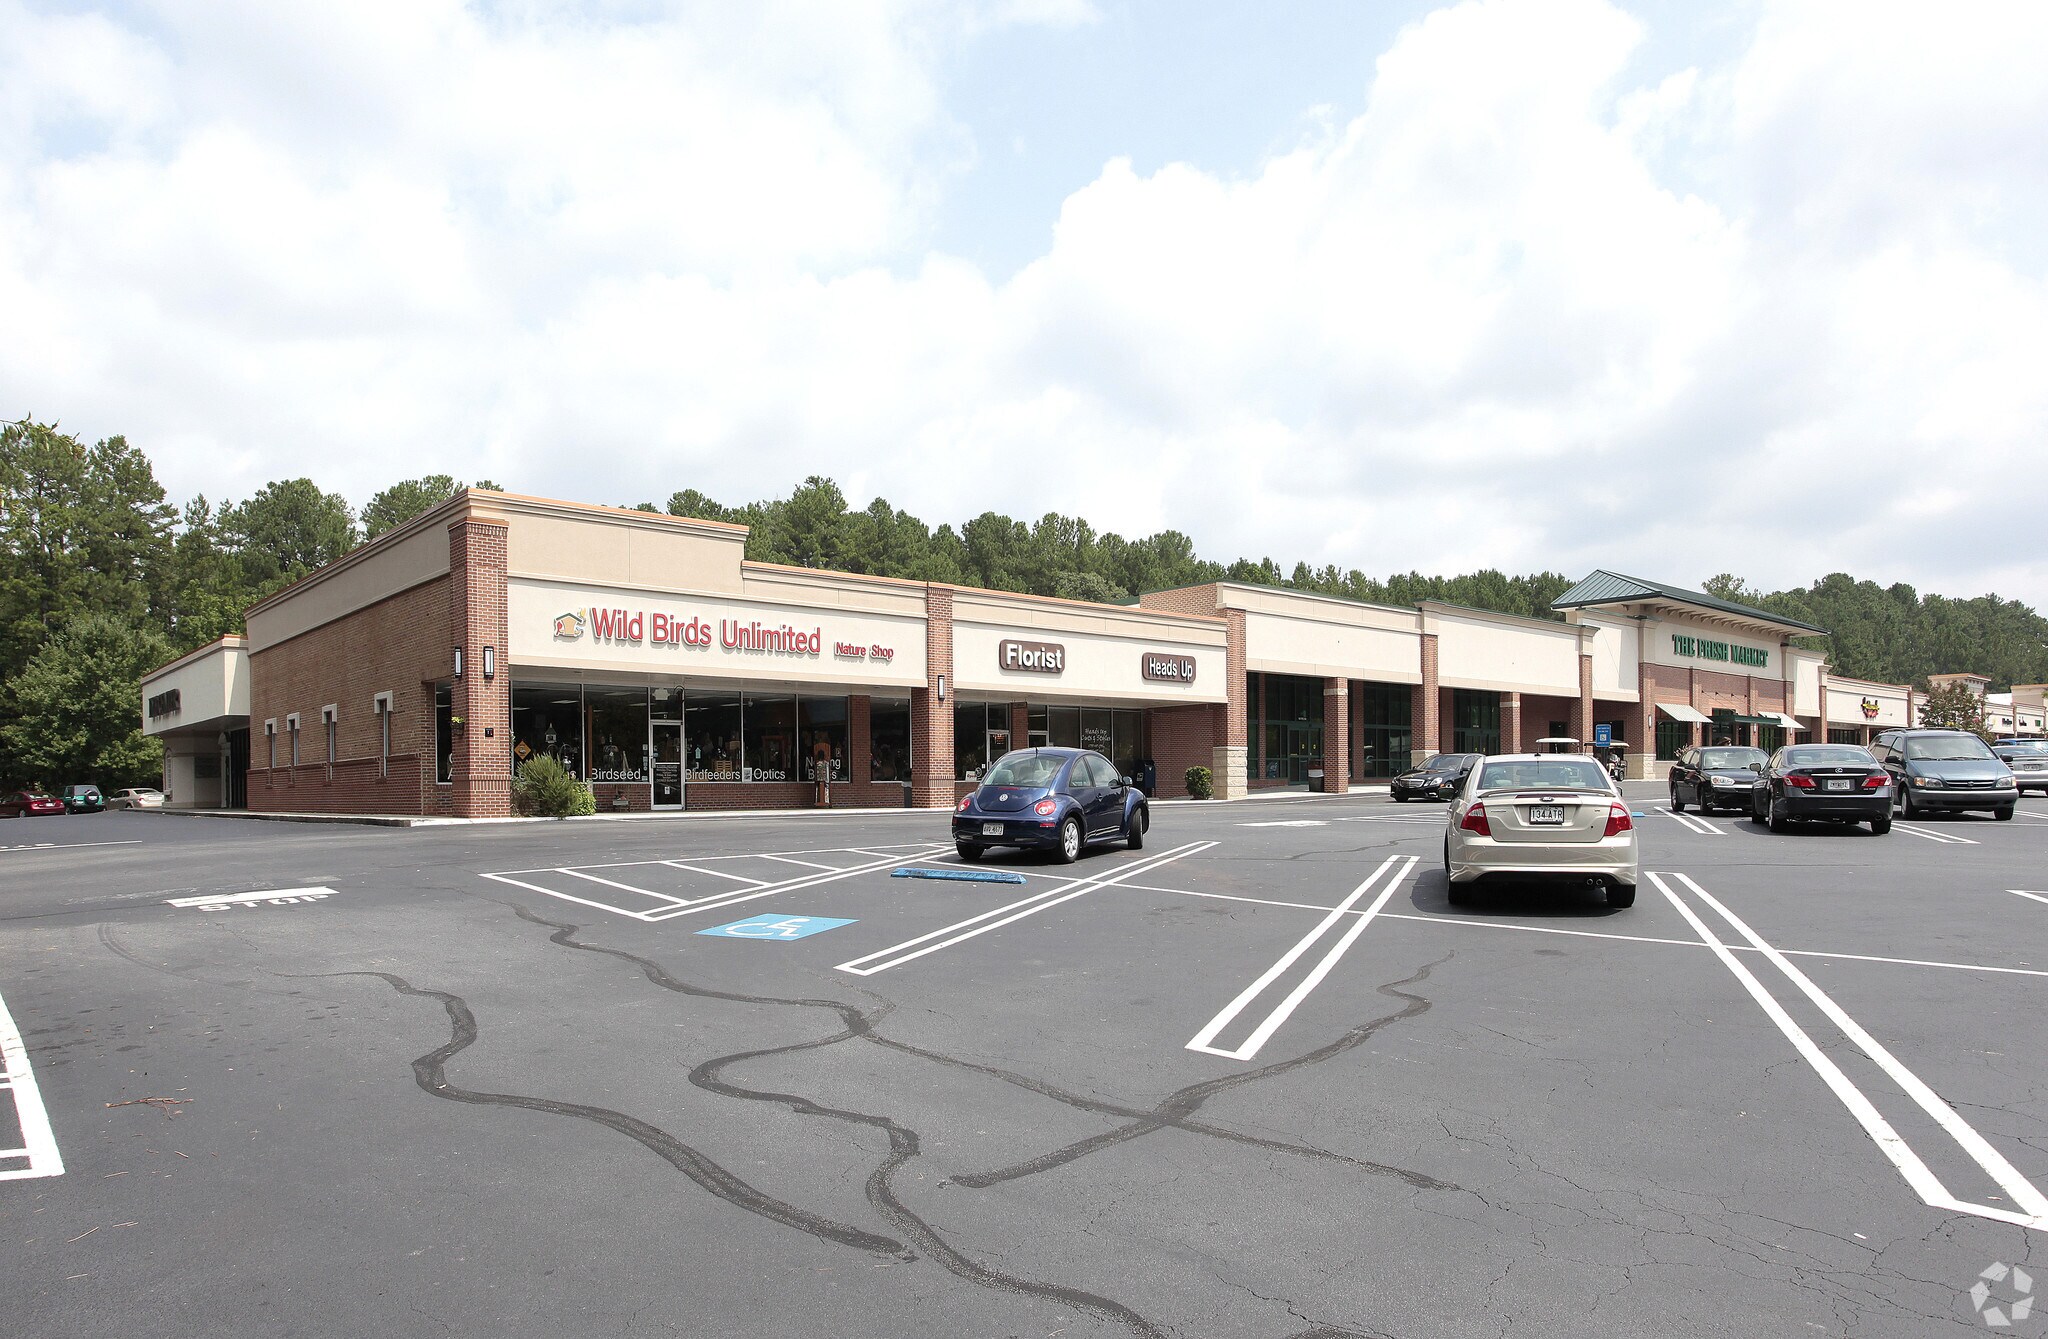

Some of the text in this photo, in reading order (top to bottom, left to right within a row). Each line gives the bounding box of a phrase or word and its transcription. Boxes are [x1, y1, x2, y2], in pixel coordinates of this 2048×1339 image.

[591, 607, 821, 654] Wild Birds Unlimited
[836, 641, 894, 661] Nature Shop
[1005, 643, 1063, 669] Florist
[1672, 634, 1769, 668] THE FRESH MARKET
[1149, 657, 1193, 681] Heads Up
[592, 768, 641, 780] Birdseed
[685, 768, 741, 781] Birdfeeders
[753, 768, 786, 782] Optics
[197, 894, 329, 912] STOP
